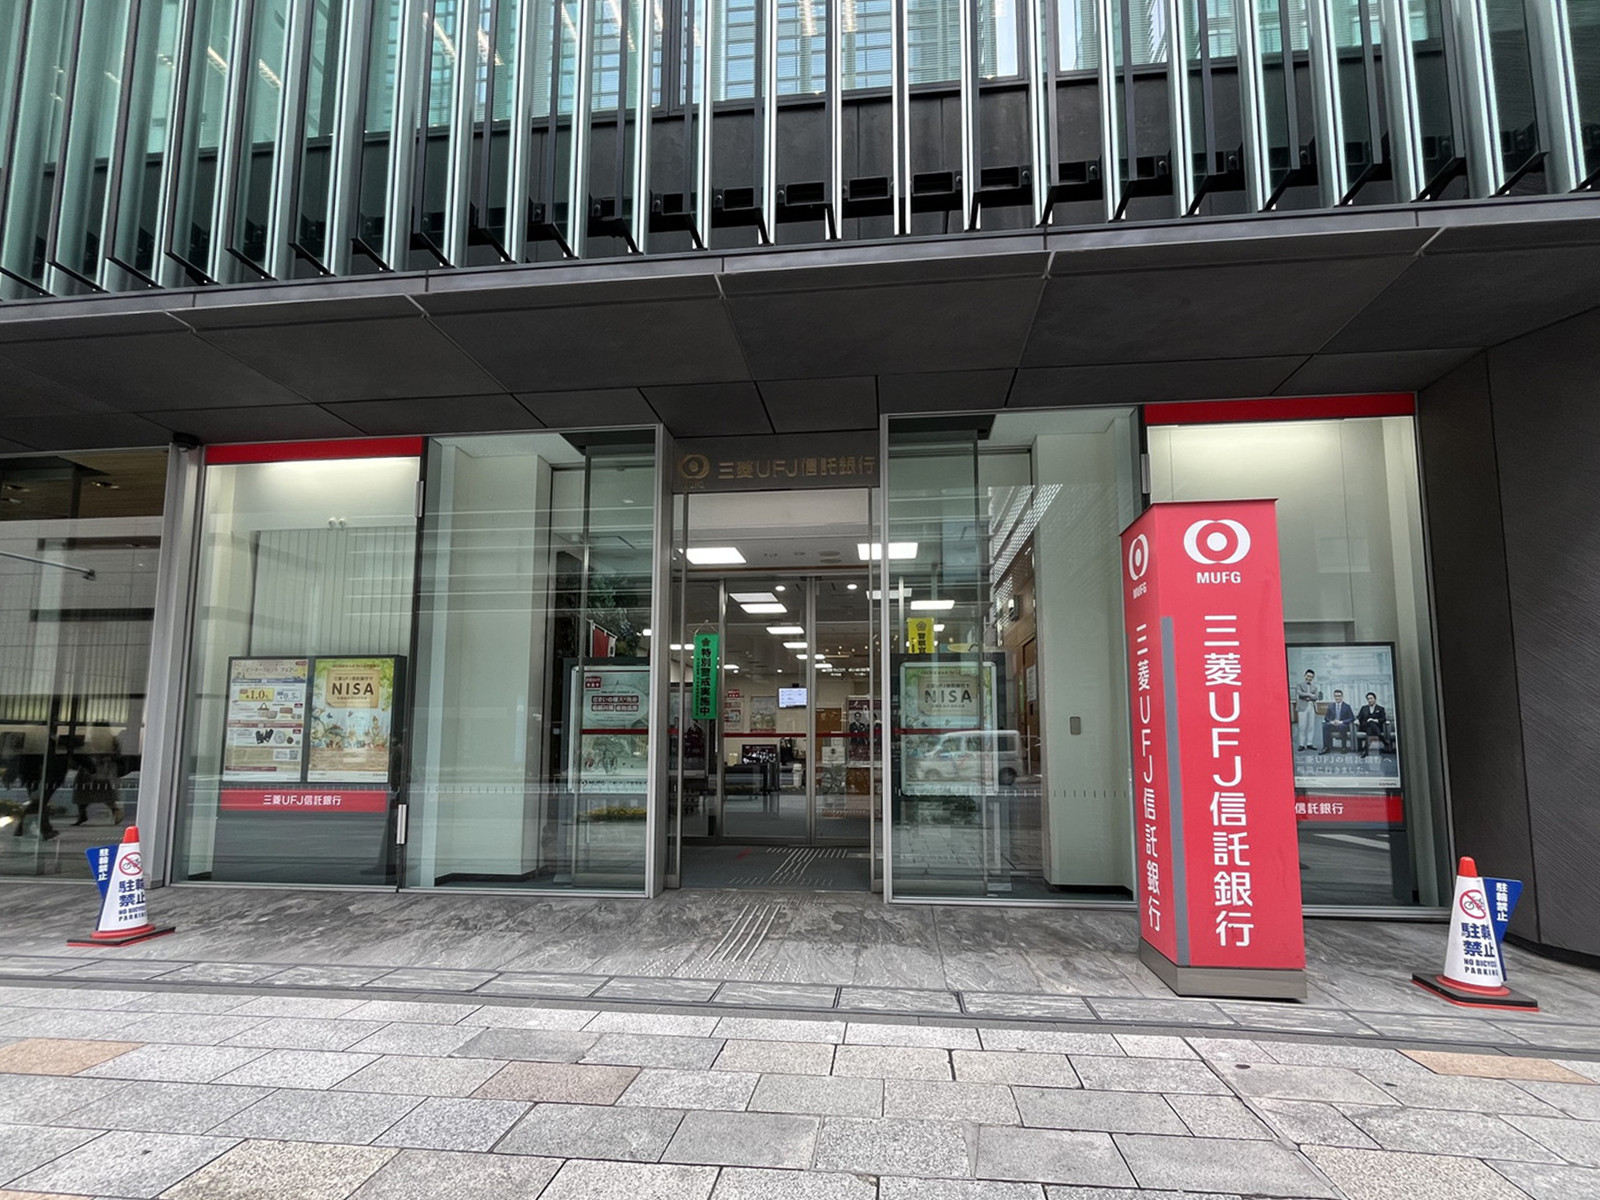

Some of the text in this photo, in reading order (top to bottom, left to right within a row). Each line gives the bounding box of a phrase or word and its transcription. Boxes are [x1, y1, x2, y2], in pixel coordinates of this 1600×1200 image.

[718, 455, 875, 479] 三菱UFJ信託銀行
[1196, 572, 1241, 584] MUFG
[1133, 582, 1147, 599] MUFG
[332, 682, 374, 696] NISA
[700, 648, 711, 716] 特別警戒実施中
[925, 689, 972, 703] NISA
[1135, 623, 1162, 933] 三菱UFJ信託銀行
[1204, 615, 1254, 948] 三菱UFJ信託銀行
[263, 794, 342, 806] 三菱UFJ信託銀行
[1463, 940, 1495, 957] 禁止
[1463, 958, 1474, 966] NO
